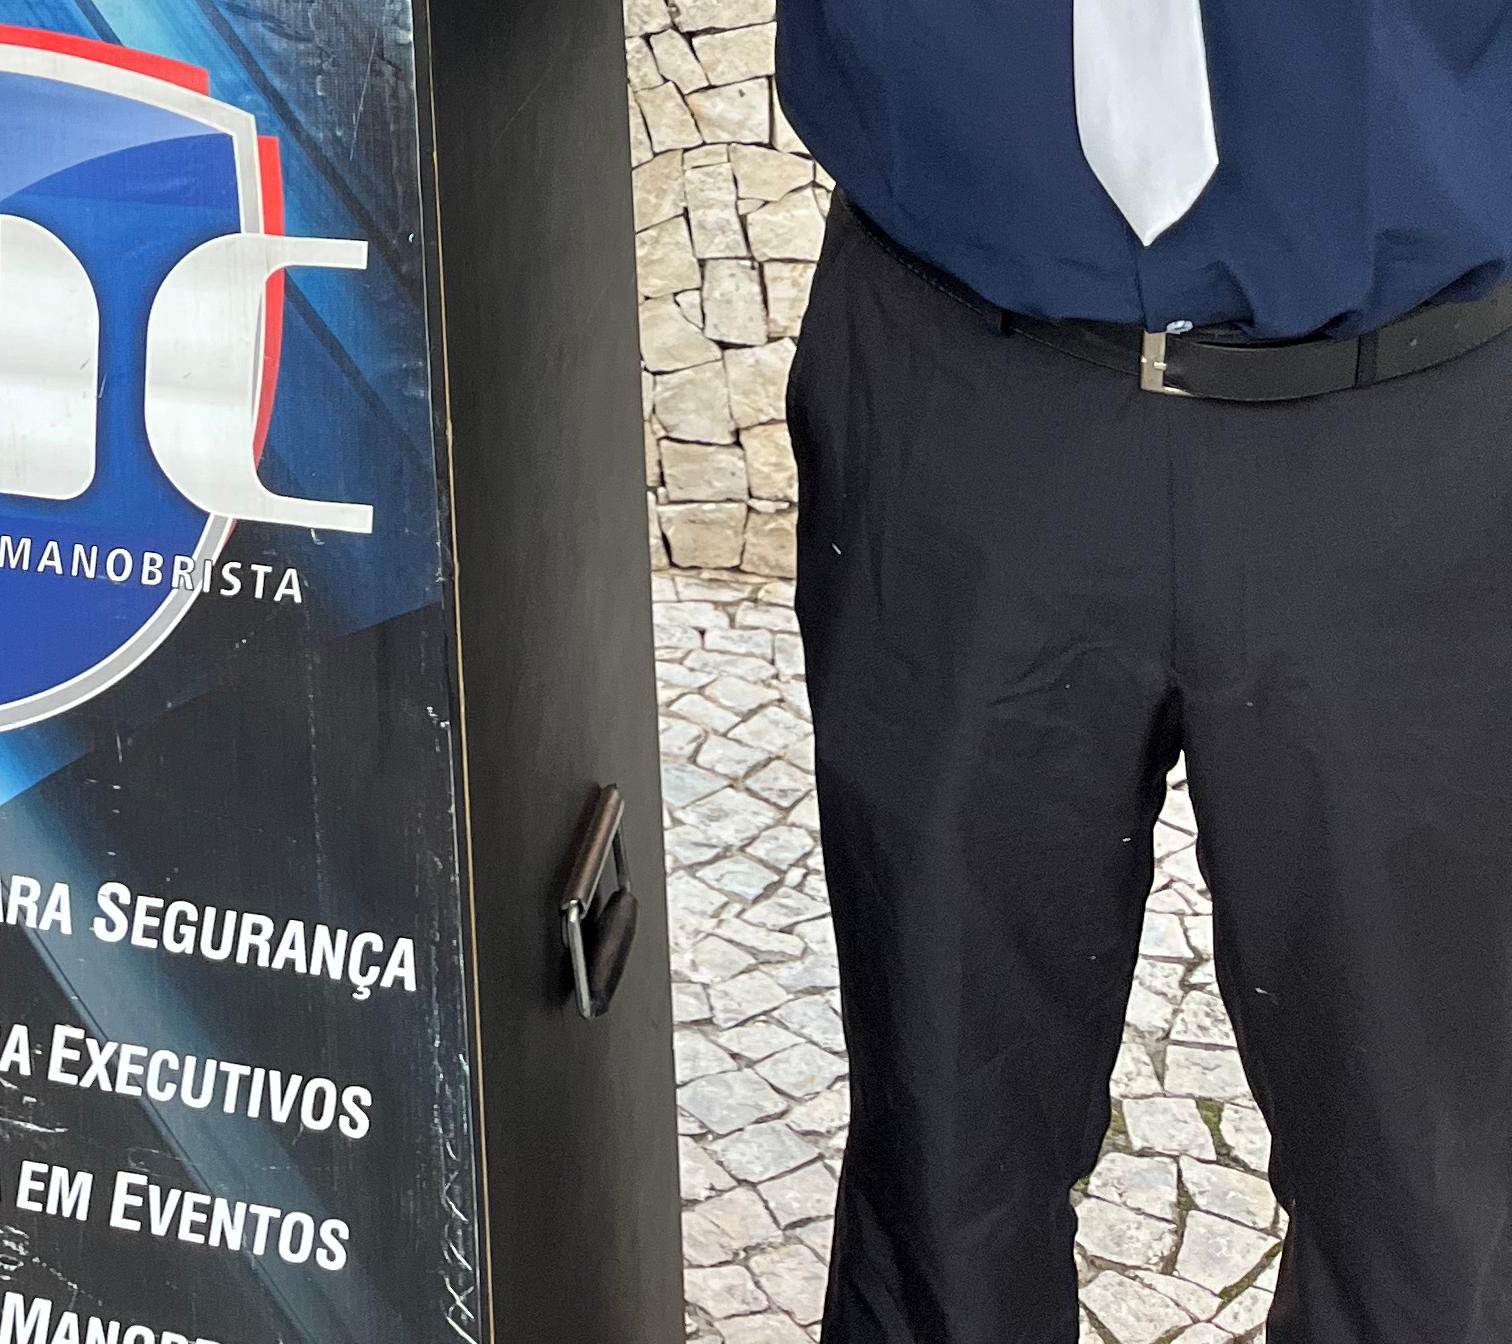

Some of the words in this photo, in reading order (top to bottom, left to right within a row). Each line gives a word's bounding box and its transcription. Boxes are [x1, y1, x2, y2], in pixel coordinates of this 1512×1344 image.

[89, 881, 418, 1002] SEGURANÇA
[47, 1024, 373, 1140] EXECUTIVOS
[16, 1160, 94, 1222] EM
[109, 1170, 351, 1272] EVENTOS
